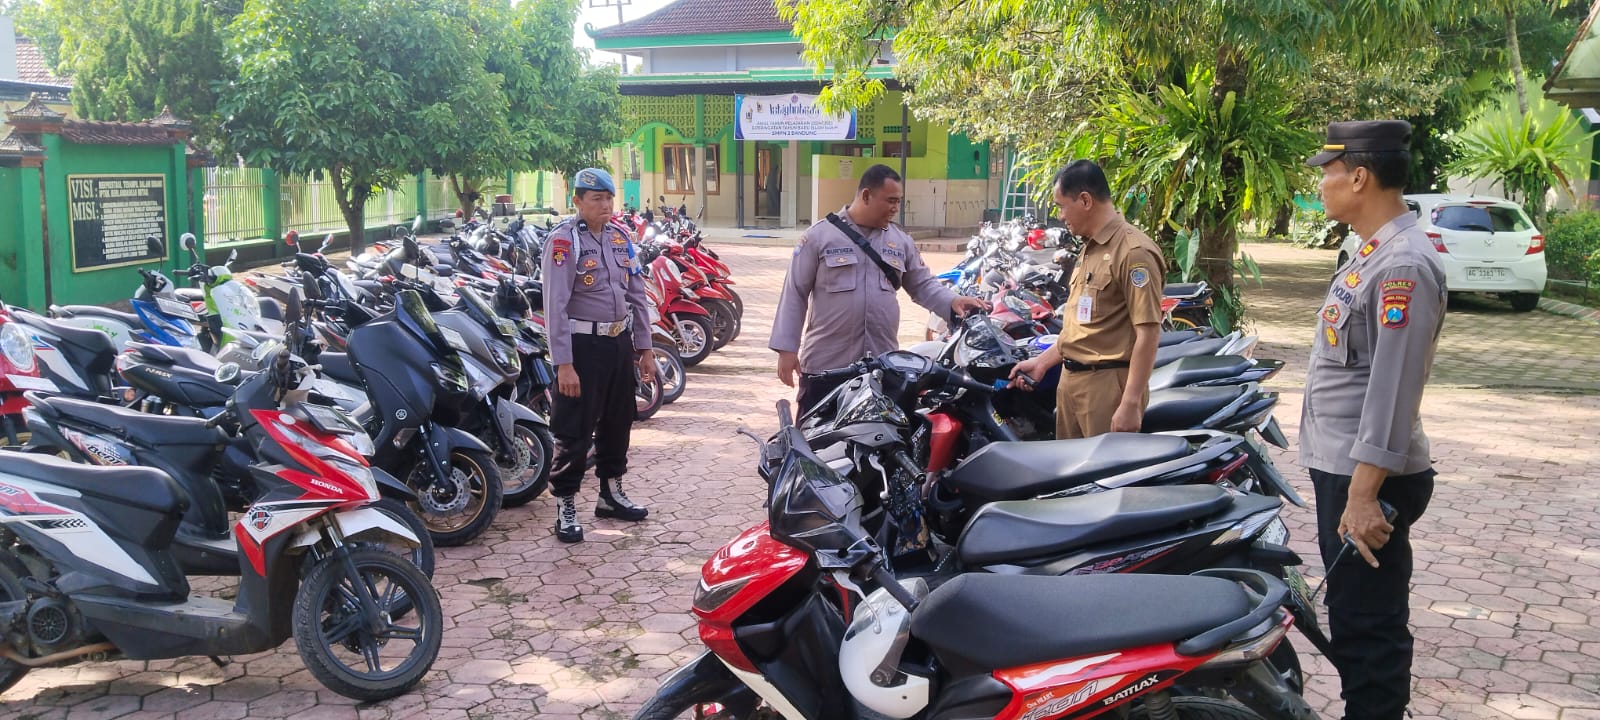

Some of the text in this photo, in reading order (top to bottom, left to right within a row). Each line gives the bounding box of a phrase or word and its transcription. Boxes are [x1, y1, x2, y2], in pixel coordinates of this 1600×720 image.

[882, 248, 905, 258] POLRI
[1382, 280, 1412, 288] POLRES
[1332, 286, 1354, 305] POLRI
[310, 478, 344, 495] HONDA
[1103, 674, 1159, 706] BATTLAX
